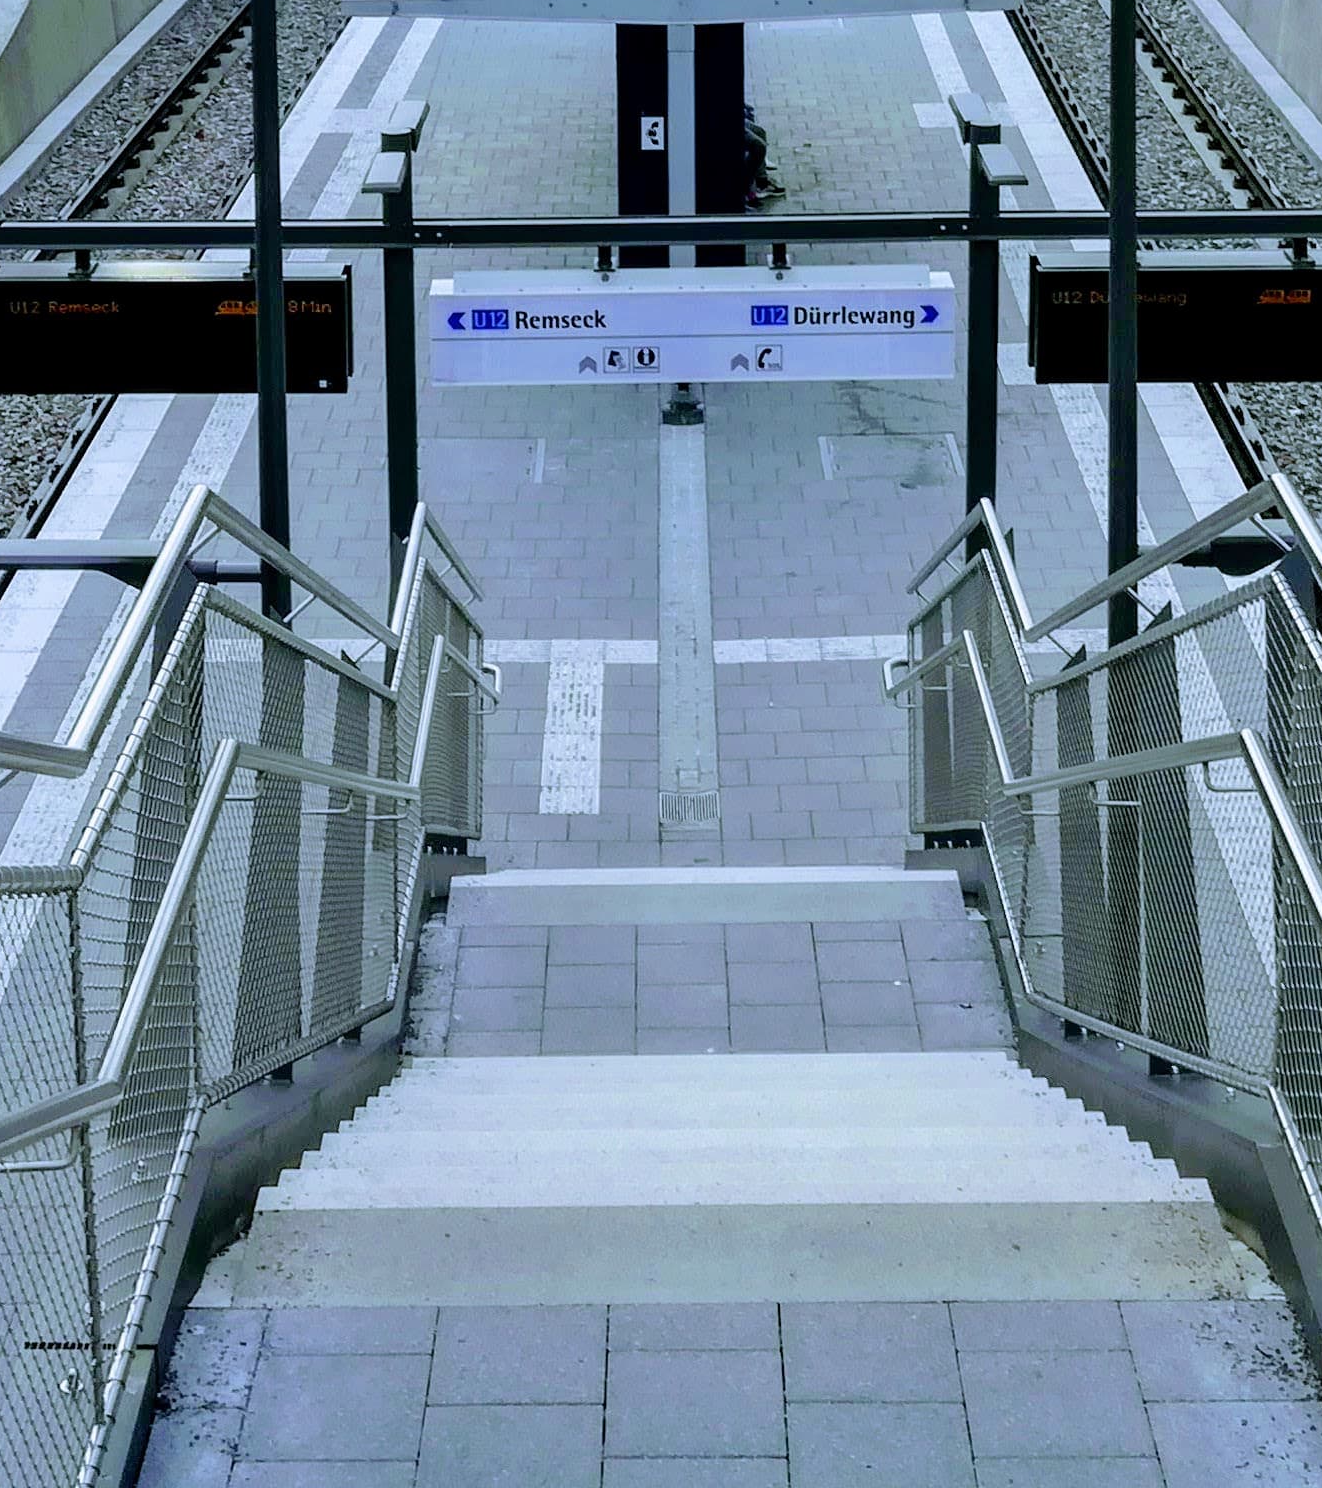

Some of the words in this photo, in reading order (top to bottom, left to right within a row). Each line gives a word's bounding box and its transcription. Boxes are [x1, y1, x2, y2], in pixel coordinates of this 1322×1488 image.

[1052, 290, 1083, 305] U12
[9, 301, 41, 315] U12
[48, 300, 120, 314] Remseck
[301, 299, 333, 313] Min
[473, 311, 508, 329] U12
[515, 309, 607, 330] Remseck
[752, 307, 787, 324] U12
[793, 305, 916, 329] Dürrlewang
